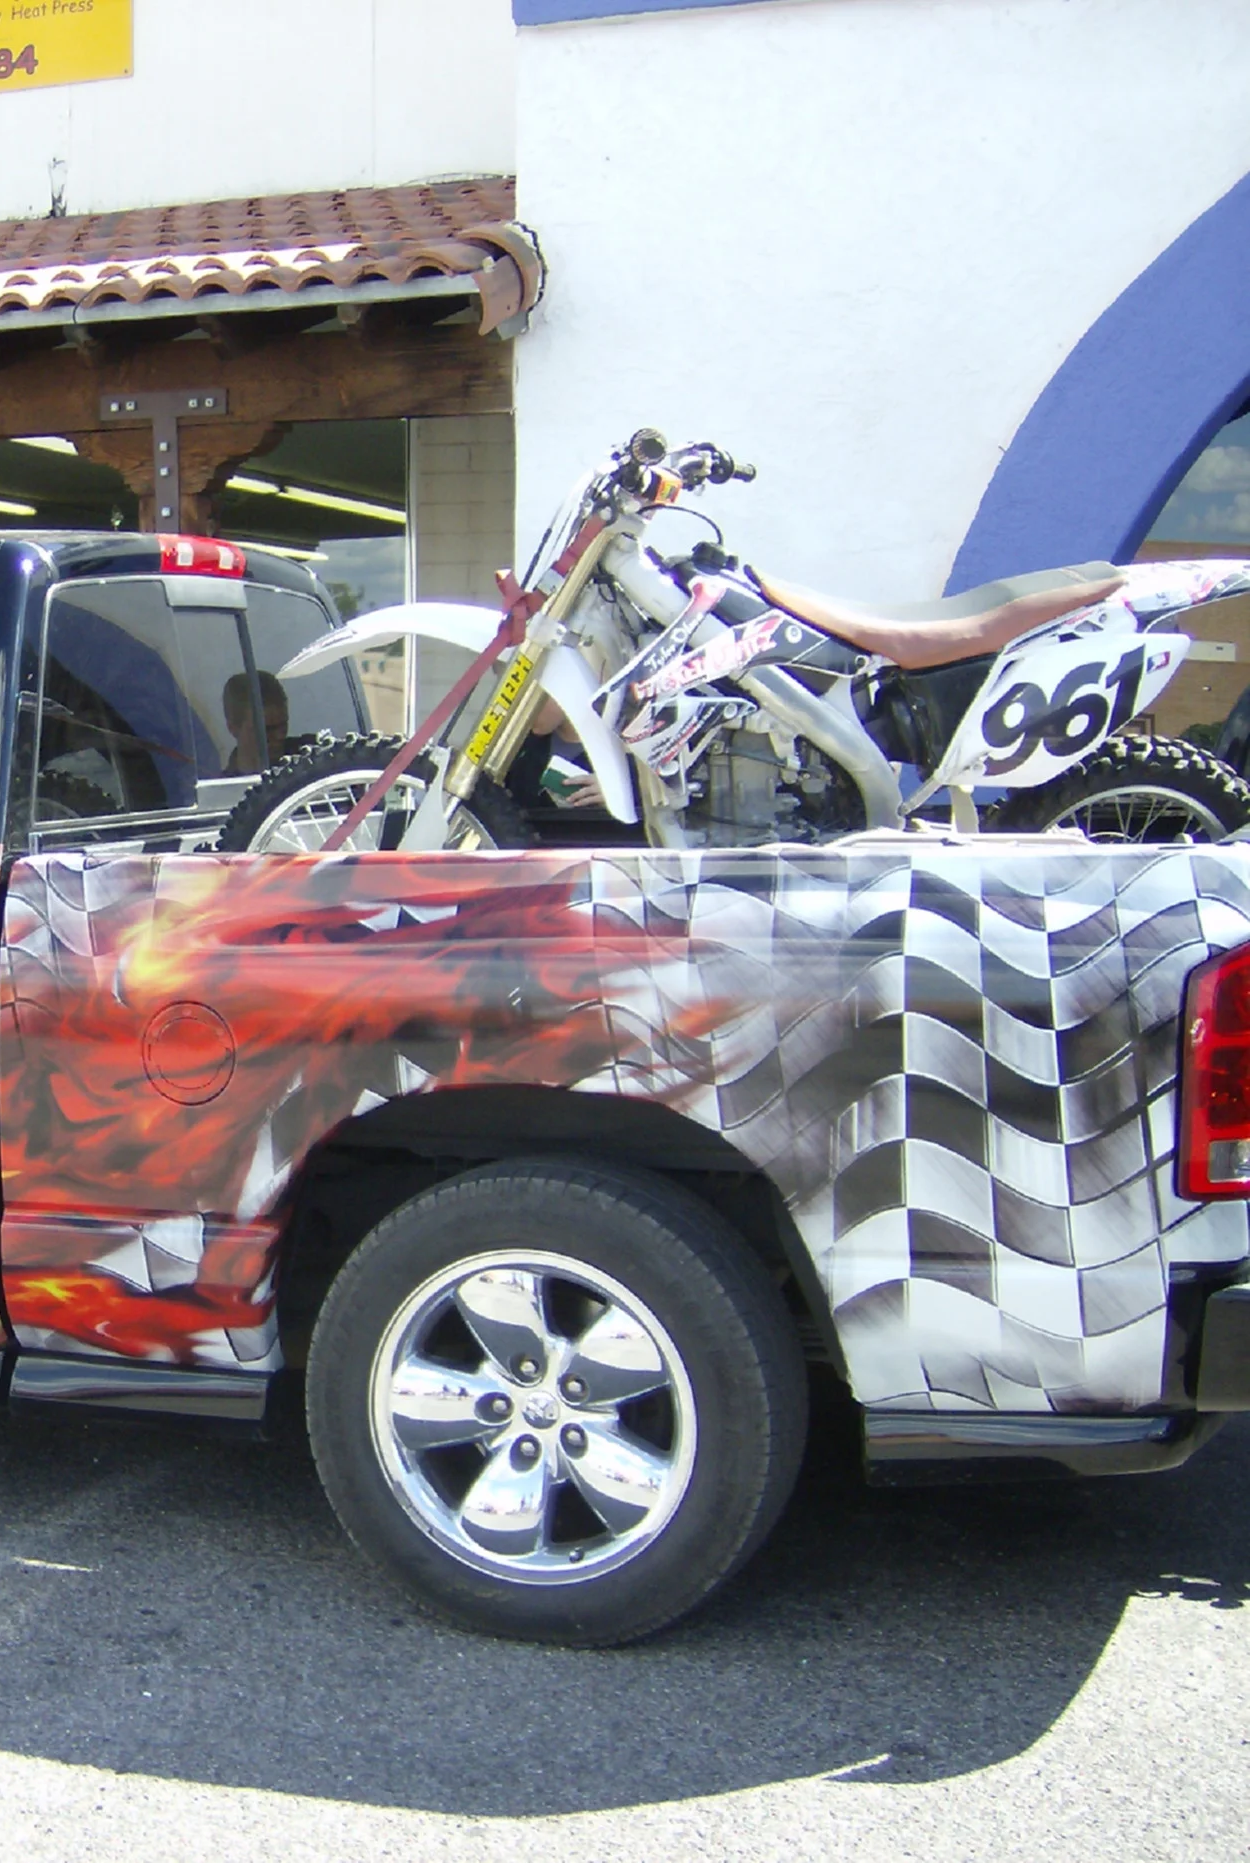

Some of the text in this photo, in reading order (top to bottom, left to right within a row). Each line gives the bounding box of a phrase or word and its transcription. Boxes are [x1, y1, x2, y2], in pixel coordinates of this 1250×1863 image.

[11, 3, 47, 20] Heat
[52, 0, 94, 15] Press
[982, 644, 1146, 776] 961
